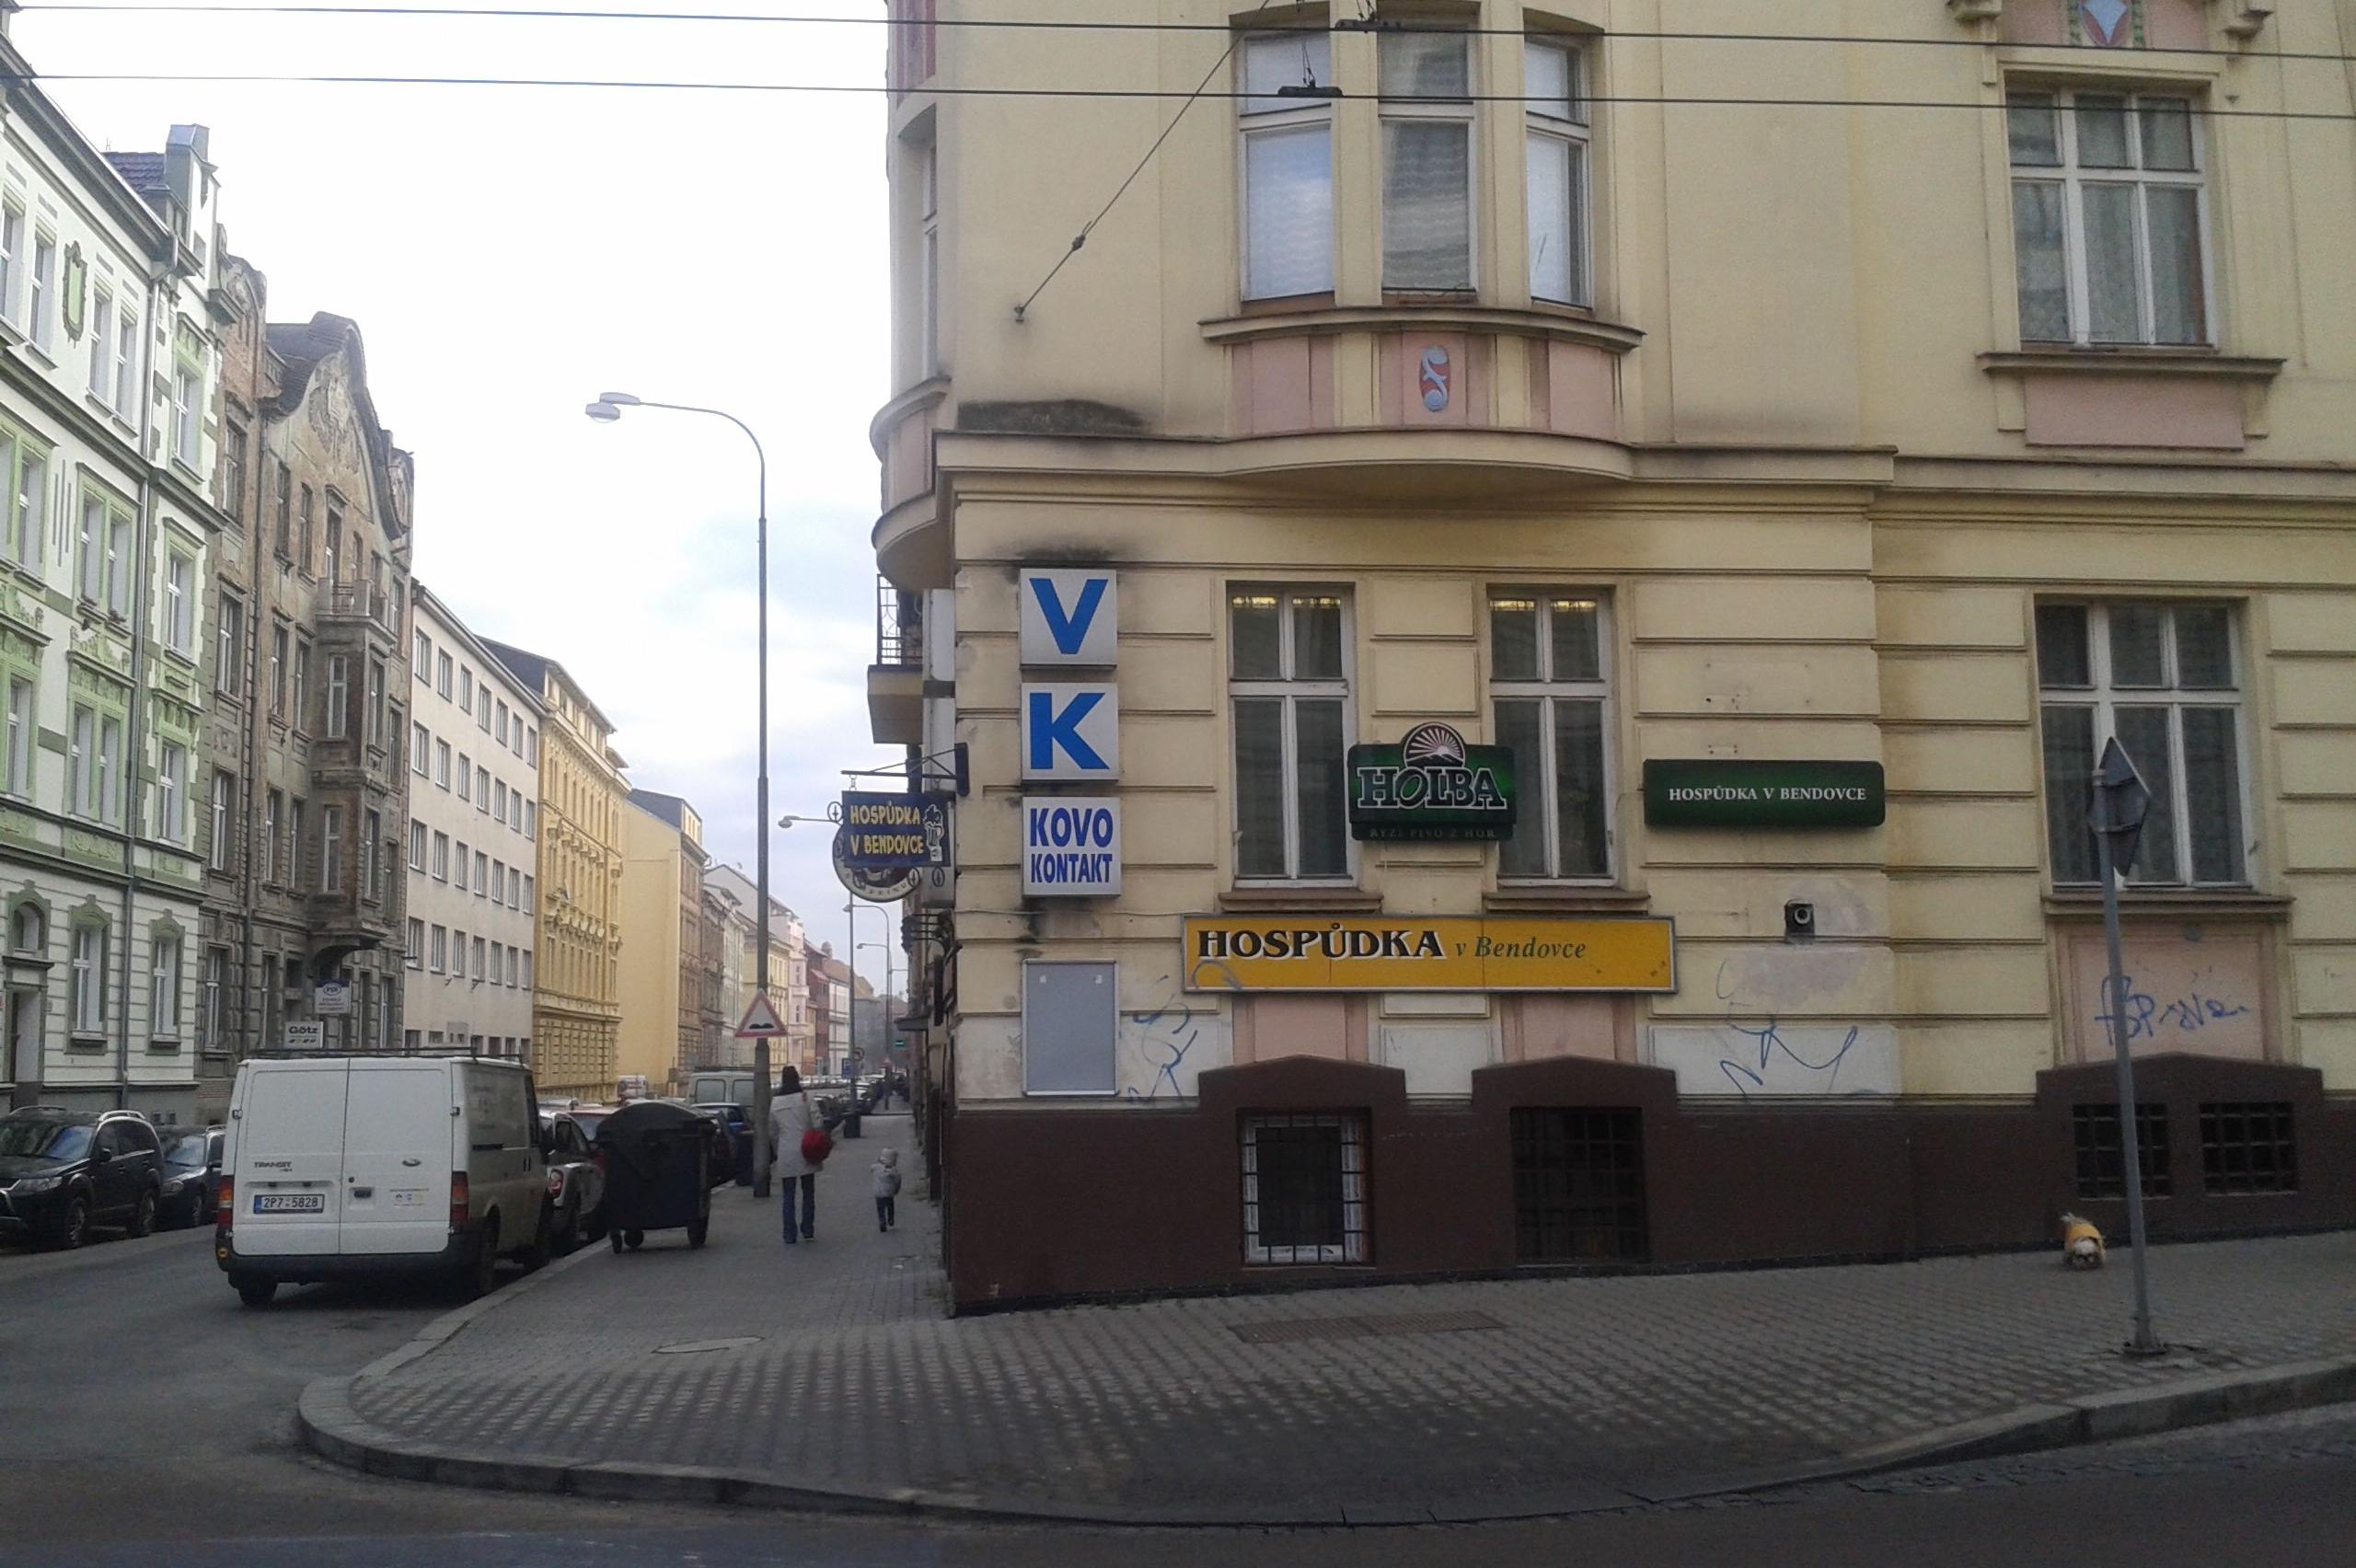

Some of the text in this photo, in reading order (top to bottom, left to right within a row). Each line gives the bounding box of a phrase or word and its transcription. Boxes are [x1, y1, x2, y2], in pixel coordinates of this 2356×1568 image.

[1029, 578, 1109, 654] V
[1029, 692, 1110, 769] K
[1357, 767, 1507, 810] HOLBA
[1669, 785, 1867, 801] HOSPŮDKA V BENDOVCE
[1029, 807, 1114, 847] KOVO
[1464, 828, 1496, 838] HOR
[850, 835, 924, 856] V BENDOVCE
[1030, 853, 1114, 884] KONTAKT
[1197, 923, 1586, 961] HOSPŮDKA v Bendovce
[264, 1198, 318, 1208] 2P7 5828
